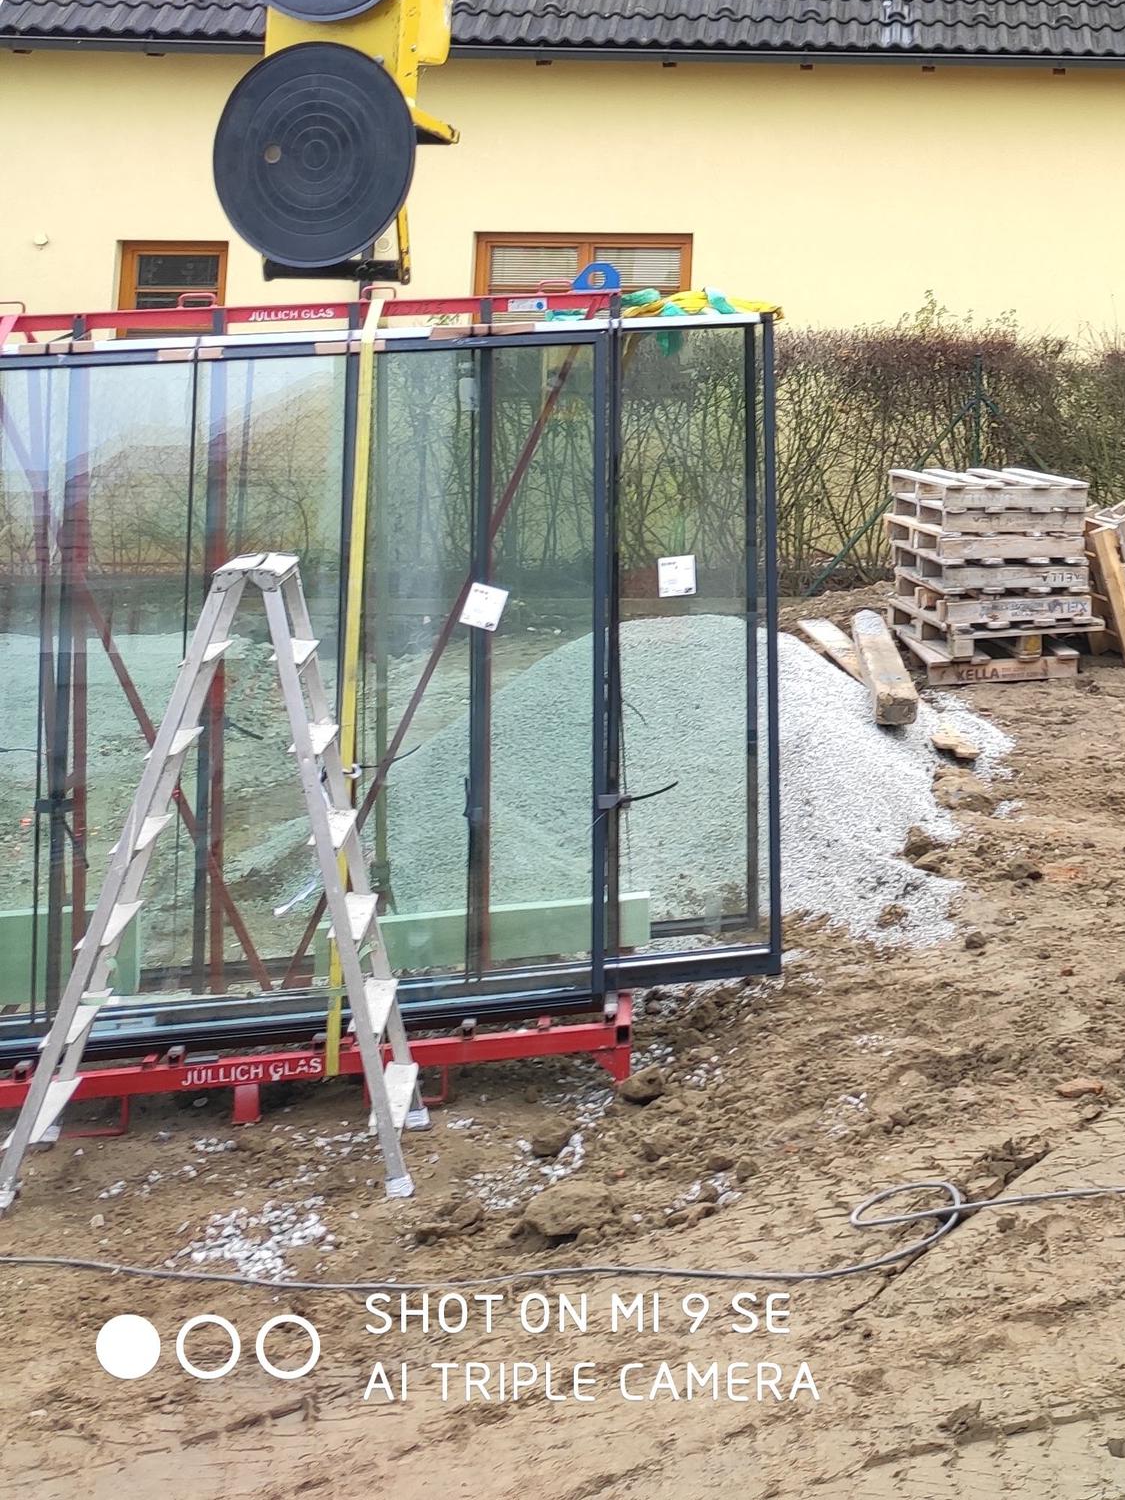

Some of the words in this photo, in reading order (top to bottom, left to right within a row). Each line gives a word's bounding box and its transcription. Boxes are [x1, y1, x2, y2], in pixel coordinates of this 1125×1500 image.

[301, 307, 335, 319] GLAS
[957, 667, 1000, 681] XELLA
[181, 1064, 264, 1086] JÜLLICH
[269, 1057, 322, 1079] GLAS
